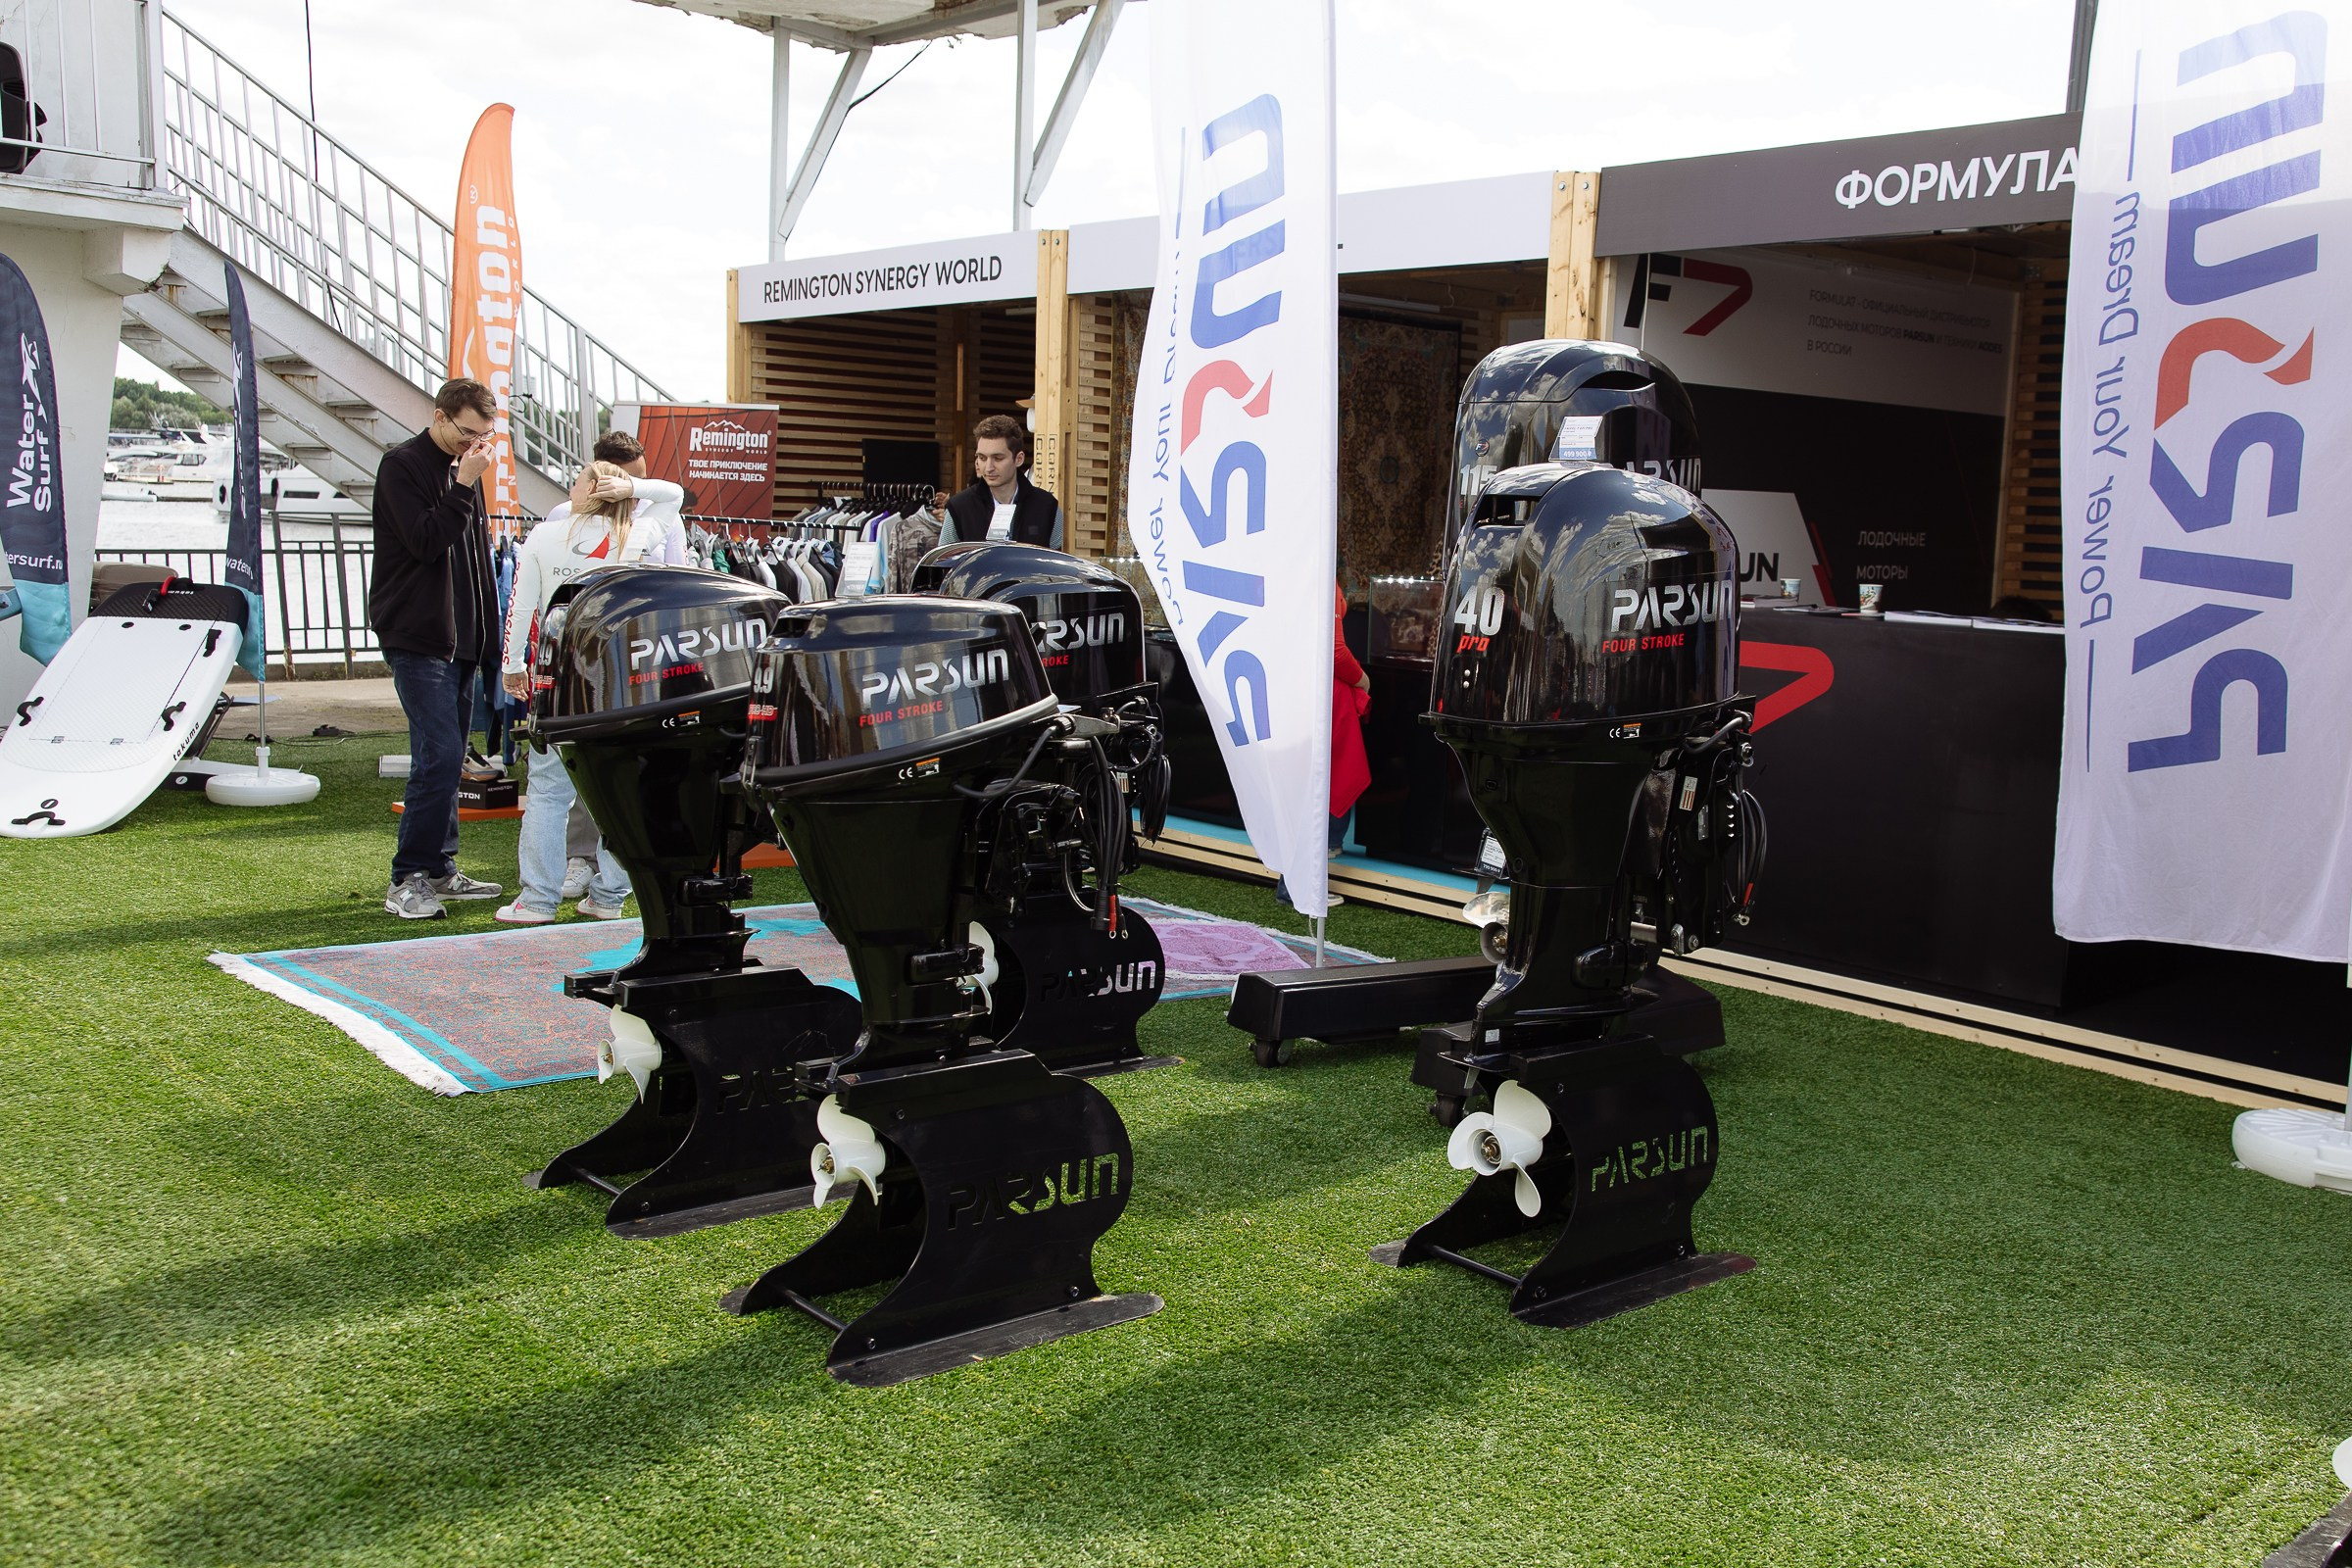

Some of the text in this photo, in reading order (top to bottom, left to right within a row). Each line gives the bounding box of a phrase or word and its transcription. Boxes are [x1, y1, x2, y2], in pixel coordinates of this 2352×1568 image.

[1835, 147, 2080, 209] ФОРМУЛА
[763, 256, 1002, 304] REMINGTON SYNERGY WORLD
[1815, 340, 1852, 357] РОССИИ
[1903, 329, 1936, 343] PARSUN
[6, 394, 34, 509] Water
[689, 427, 768, 451] Remington
[33, 429, 52, 513] Surf
[689, 470, 764, 482] НАЧИНАЕТСЯ ЗДЕСЬ
[710, 461, 767, 471] ПРИКЛЮЧЕНИЕ
[1858, 531, 1926, 548] ЛОДОЧНЫЕ
[1856, 565, 1908, 580] МОТОРЫ
[1454, 587, 1504, 636] 40
[1610, 579, 1733, 633] PARSUN
[539, 643, 553, 666] 9.9
[630, 617, 766, 670] PARSUN
[1456, 635, 1491, 653] pro
[1602, 633, 1685, 653] FOUR STROKE
[628, 662, 704, 686] FOUR STROKE
[1042, 655, 1069, 666] ROKE
[754, 666, 774, 694] 9.9
[862, 648, 1009, 710] PARSUN
[859, 701, 944, 728] FOUR STROKE
[173, 721, 200, 760] takuma
[1592, 1126, 1708, 1192] PARSUN
[948, 1152, 1120, 1231] PARSUN
